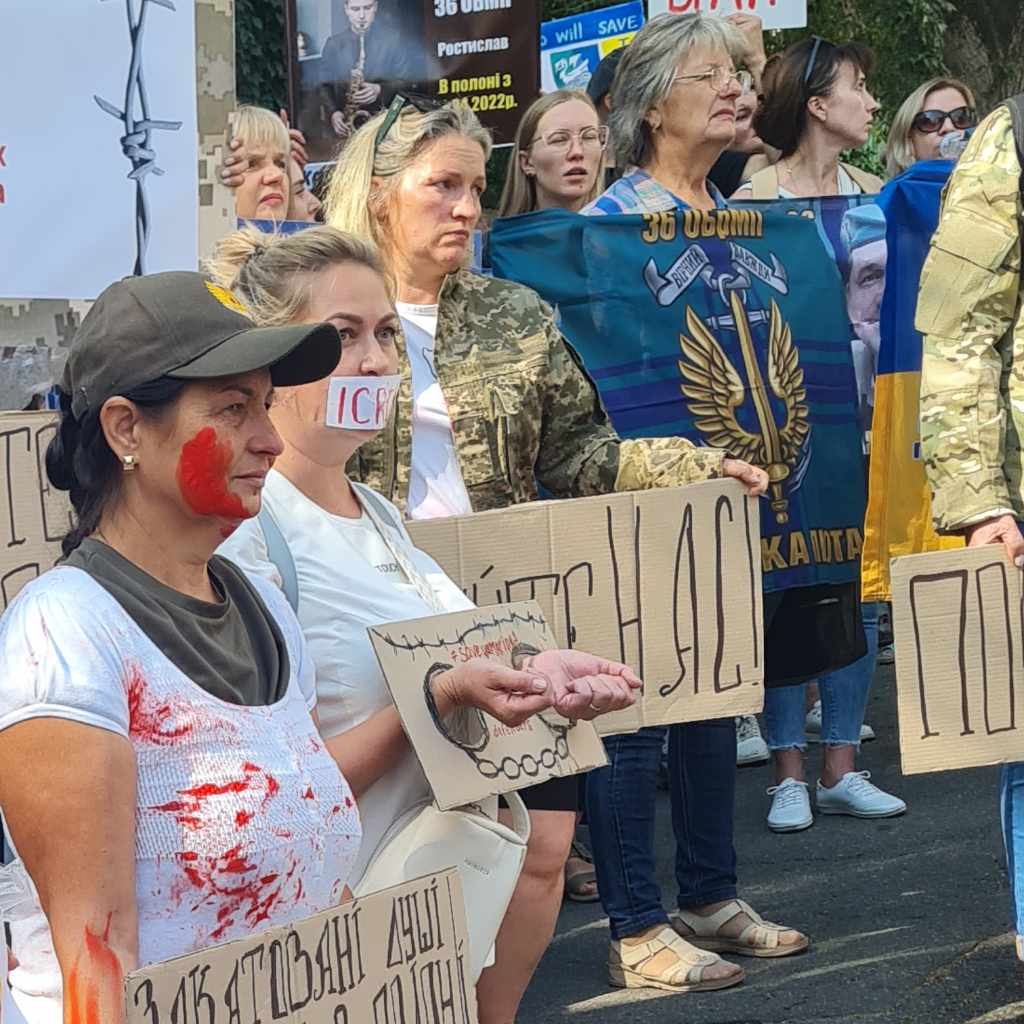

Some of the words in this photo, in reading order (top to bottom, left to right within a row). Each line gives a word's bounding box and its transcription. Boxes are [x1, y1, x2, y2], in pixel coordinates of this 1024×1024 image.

[597, 14, 638, 36] SAVE
[437, 37, 509, 57] Ростислав
[439, 79, 449, 94] В
[451, 72, 500, 93] полоні
[641, 209, 678, 243] 36
[606, 494, 761, 697] НАС!
[386, 877, 444, 968] ДУШІ
